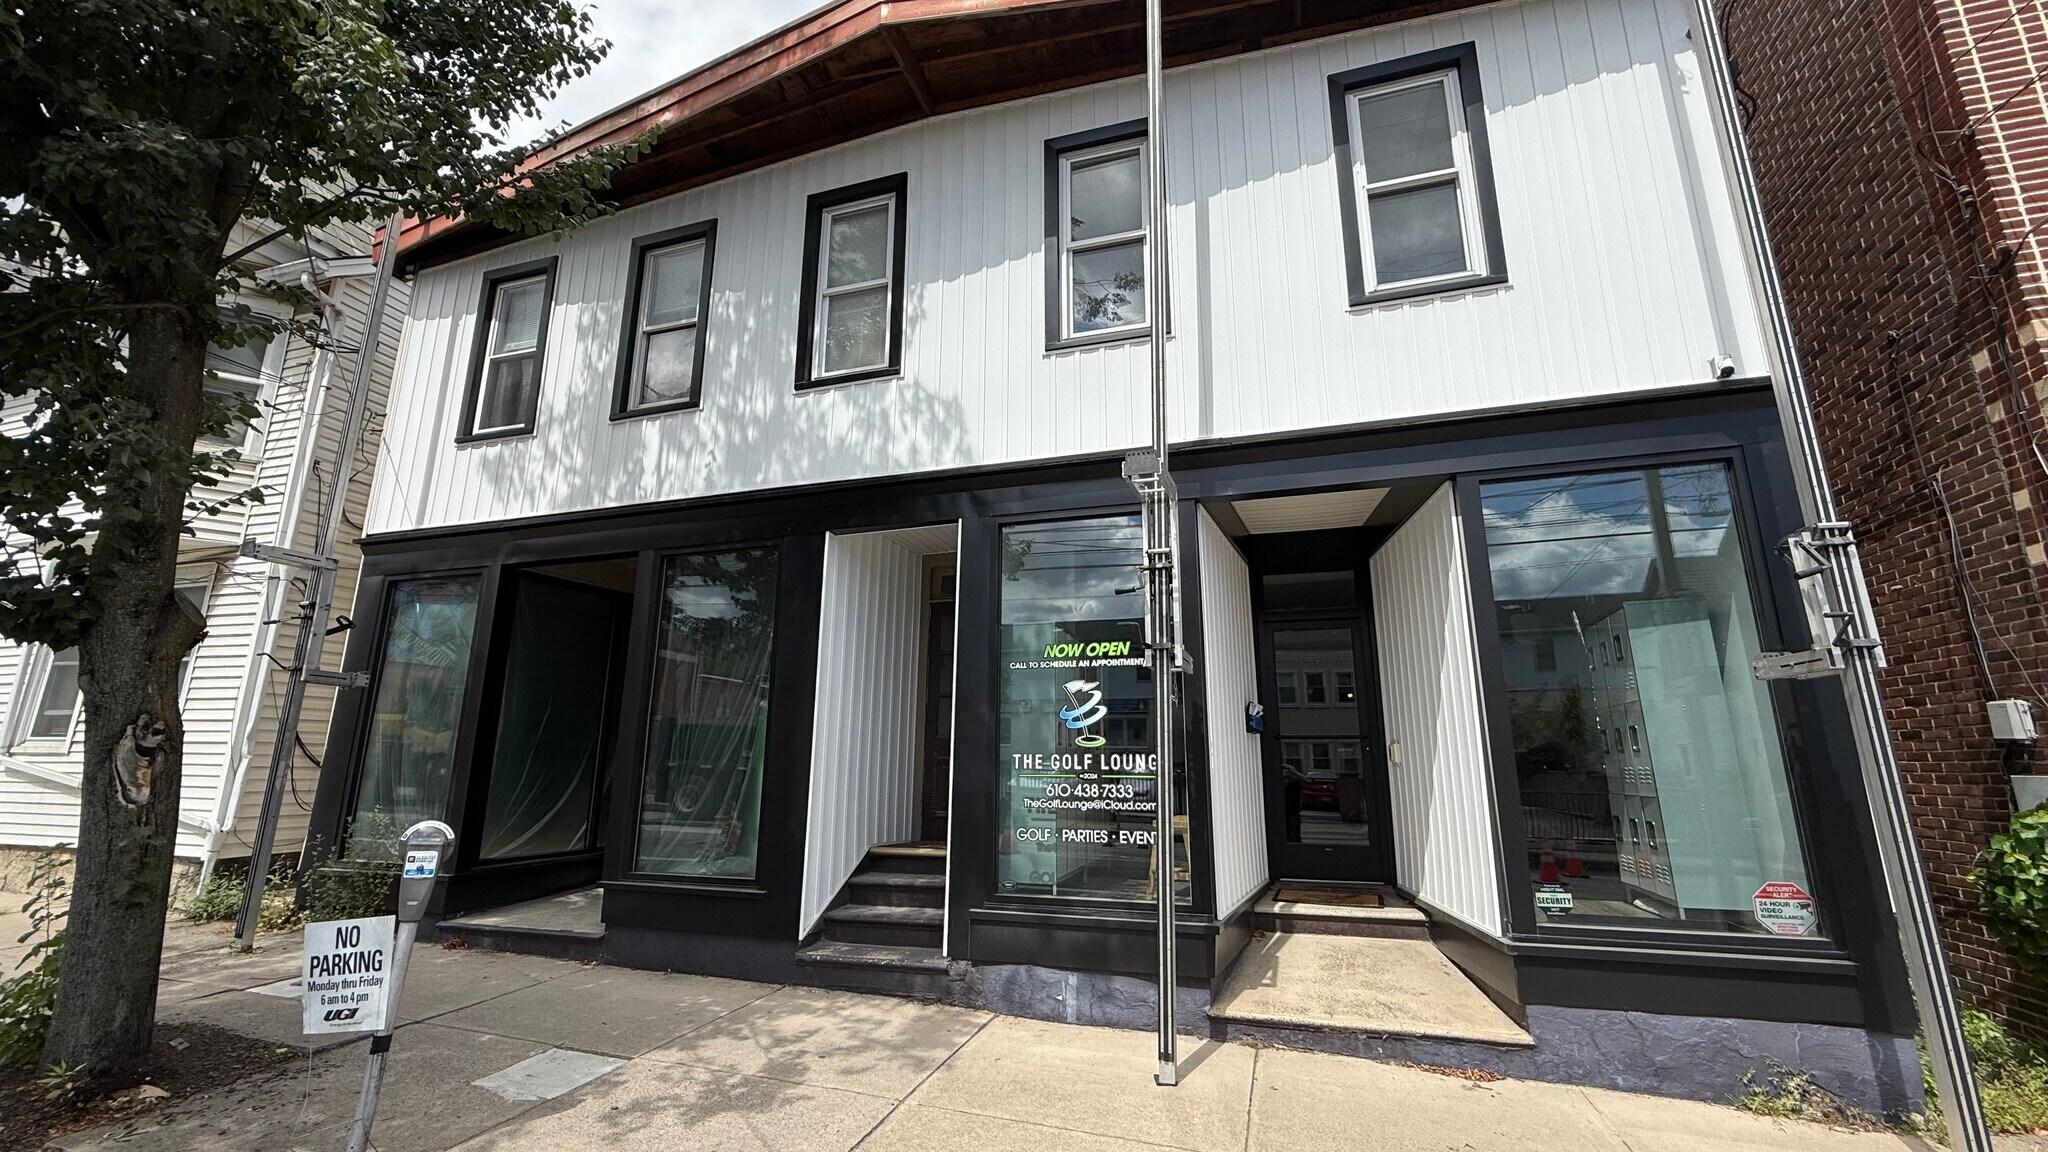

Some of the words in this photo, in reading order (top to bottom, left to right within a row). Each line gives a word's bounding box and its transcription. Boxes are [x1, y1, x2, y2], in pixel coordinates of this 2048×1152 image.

[1044, 644, 1084, 658] NOW
[1086, 641, 1131, 657] OPEN
[1040, 660, 1077, 668] SCHEDULE
[1078, 659, 1090, 667] AN
[1012, 753, 1043, 769] THE
[1051, 754, 1093, 770] GOLF
[1101, 754, 1157, 770] LOUNG
[1016, 827, 1051, 841] GOLF
[1062, 829, 1108, 843] PARTIES
[1537, 897, 1570, 905] SECURITY
[335, 925, 361, 949] NO
[309, 949, 383, 978] PARKING
[307, 979, 340, 993] Monday
[341, 978, 358, 990] thru
[358, 975, 384, 989] Friday
[320, 994, 326, 1006] 6
[327, 995, 340, 1005] am
[340, 993, 349, 1004] to
[350, 992, 355, 1003] 4
[356, 993, 369, 1006] pm
[323, 1007, 360, 1022] UGI
